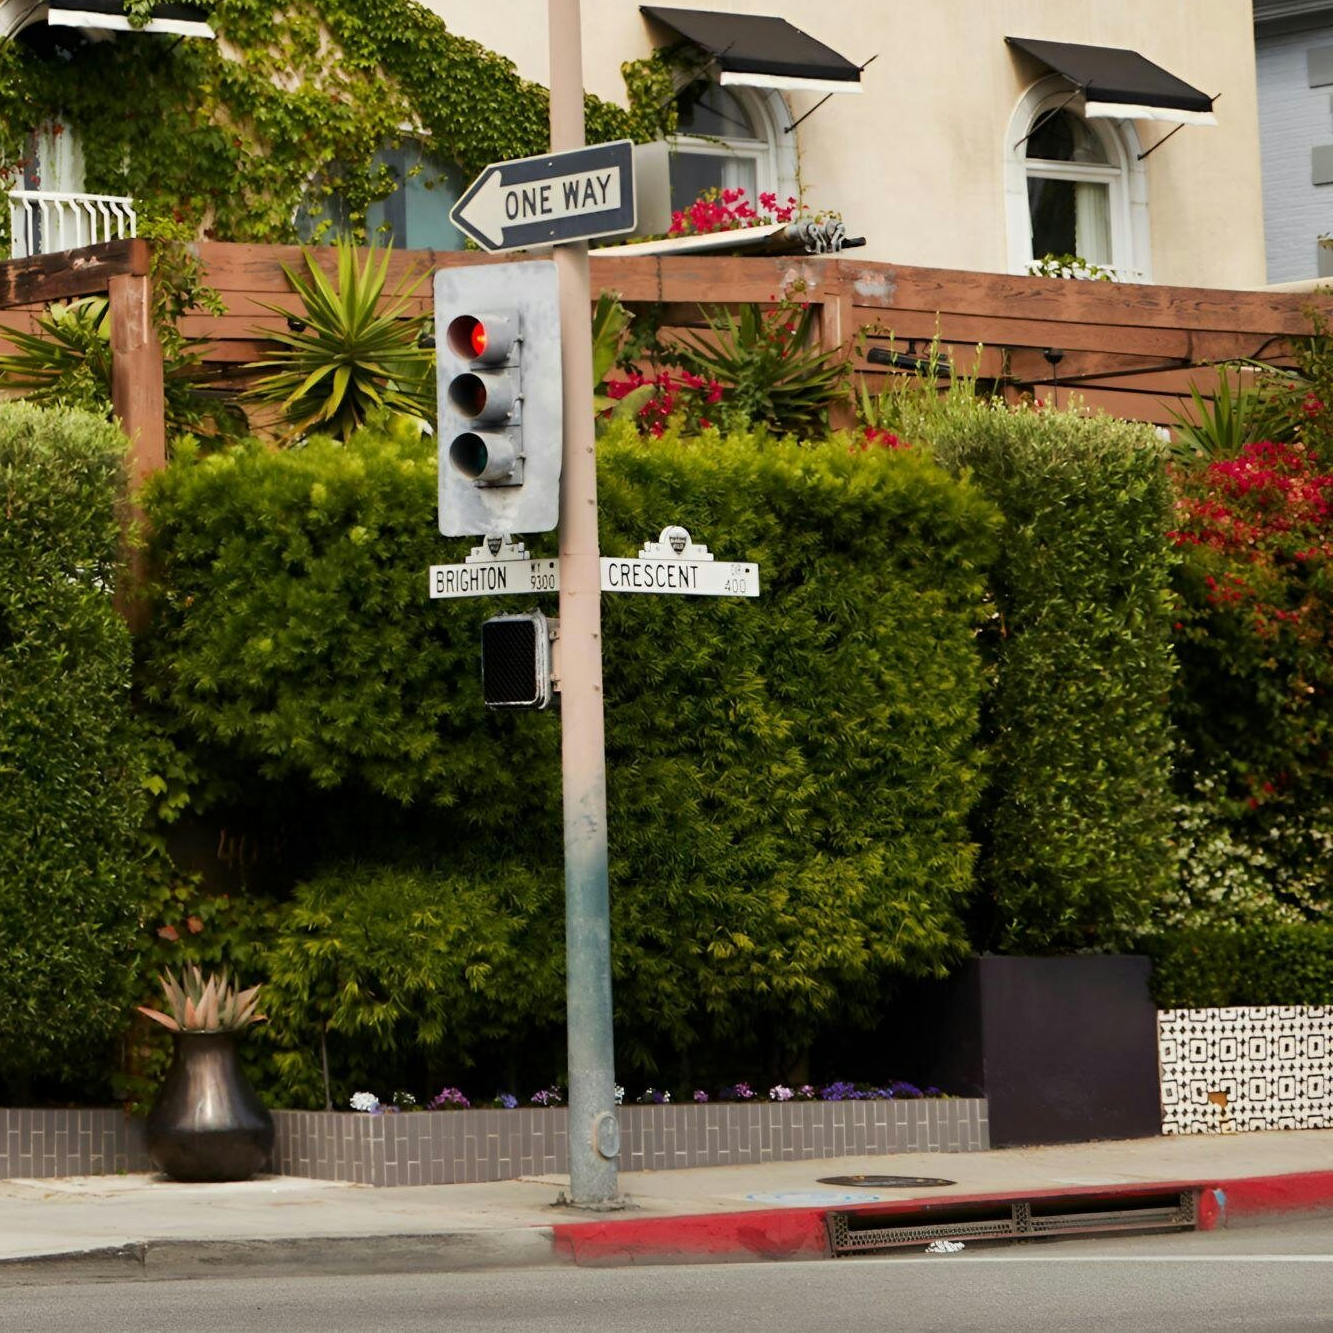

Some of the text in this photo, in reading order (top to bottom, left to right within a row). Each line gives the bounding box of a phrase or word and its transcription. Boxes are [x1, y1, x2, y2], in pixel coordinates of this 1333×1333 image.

[505, 174, 611, 220] ONE WAY
[436, 566, 507, 593] BRIGHTON
[530, 574, 555, 590] 9300
[608, 563, 699, 588] CRESCENT
[724, 578, 747, 593] 400
